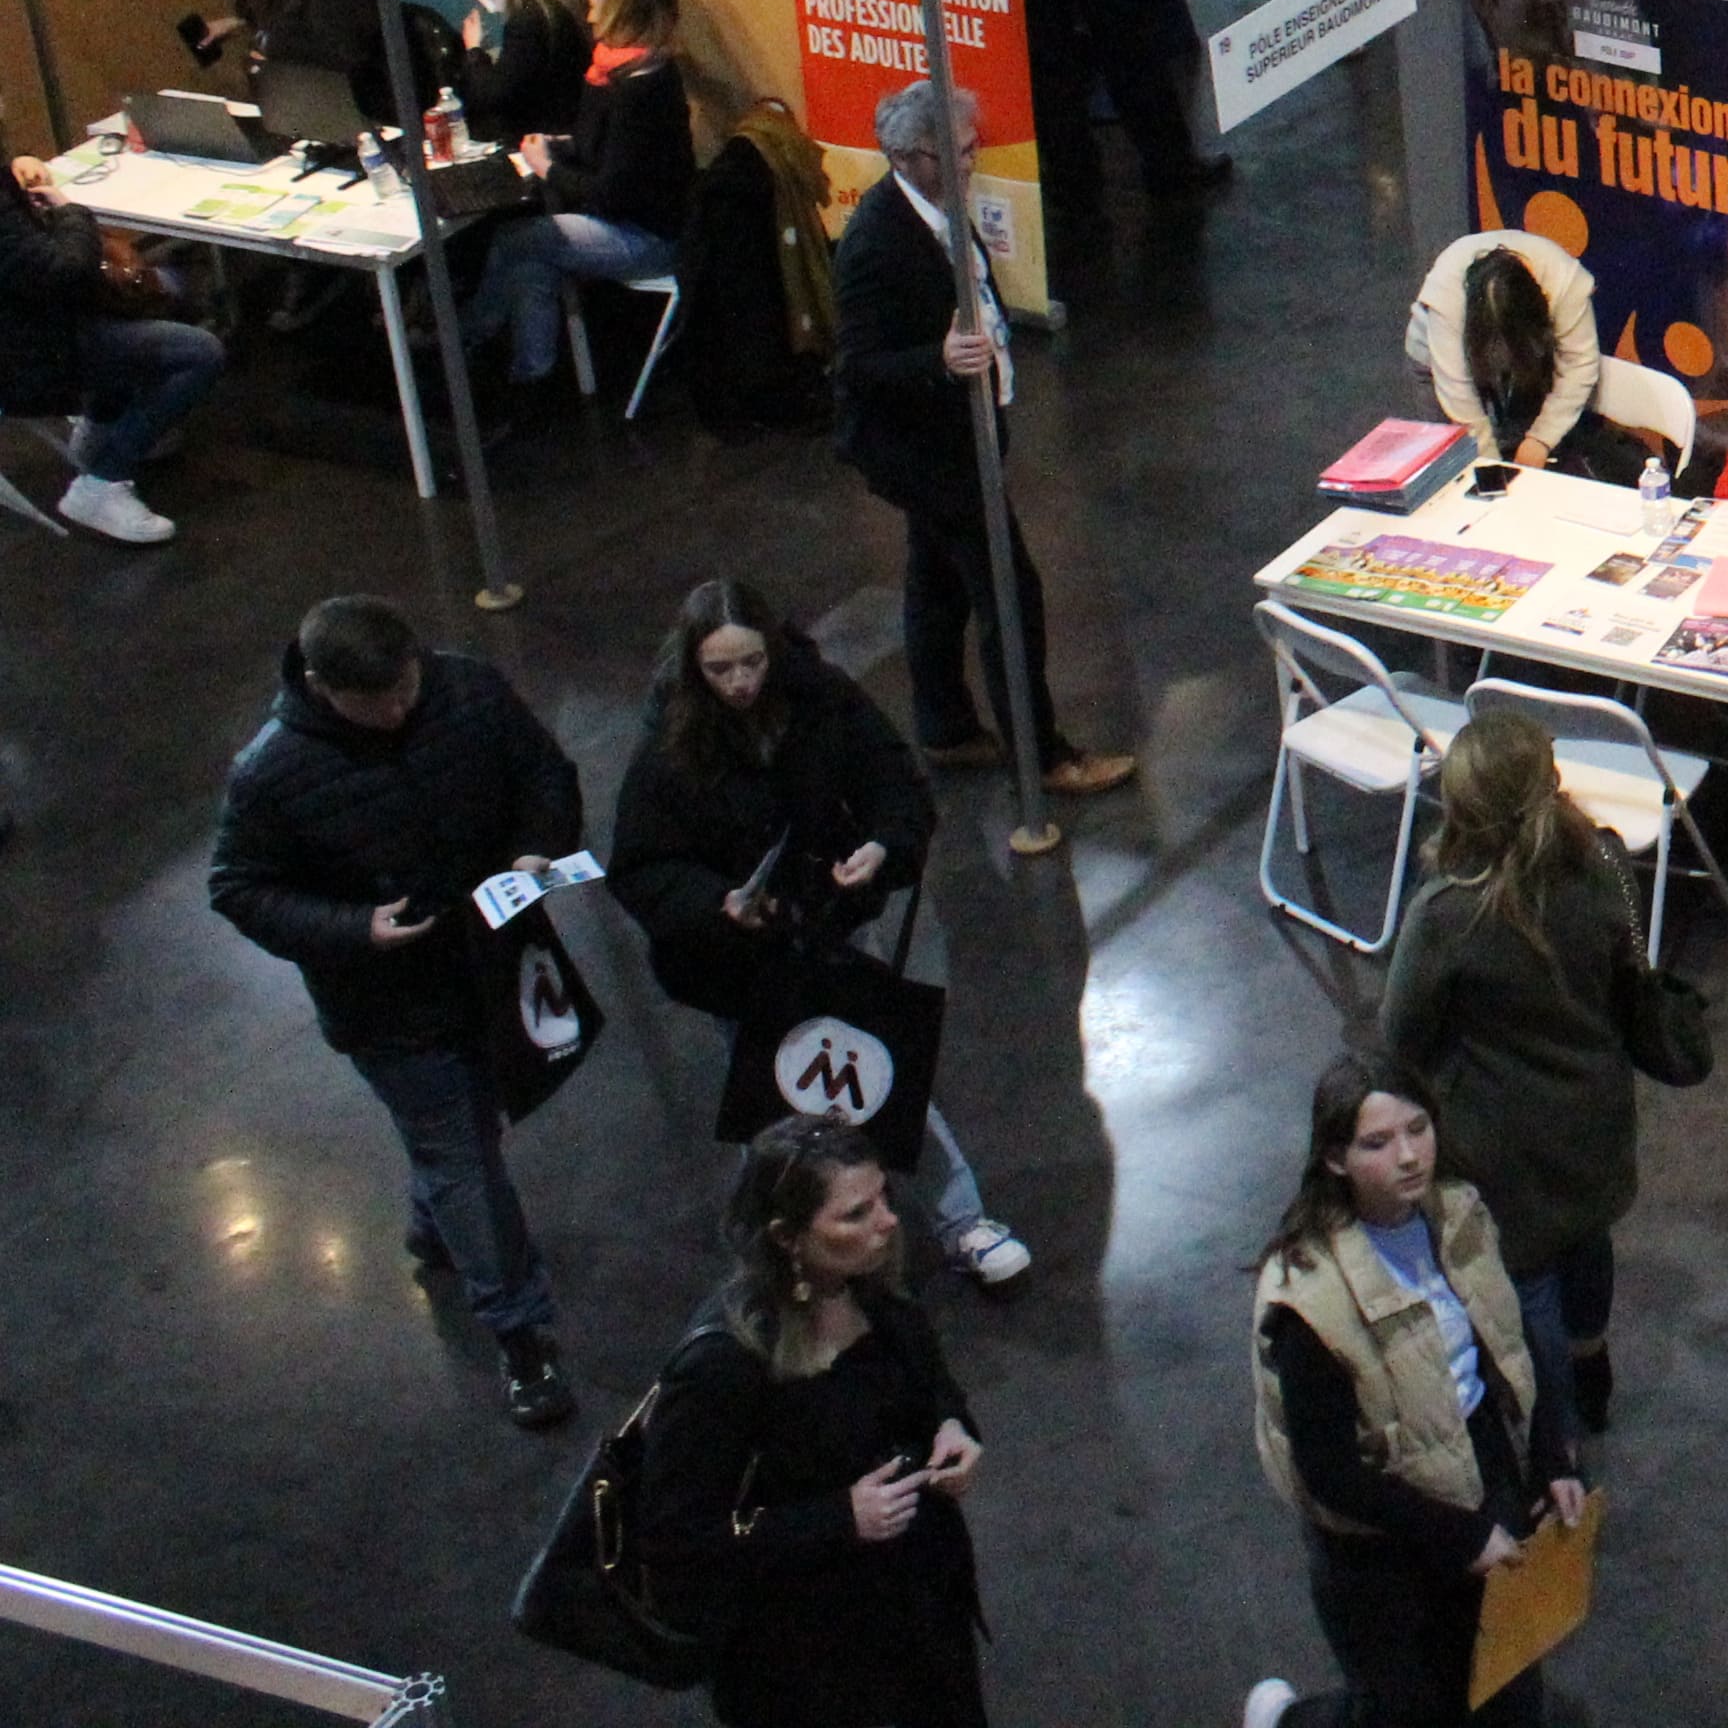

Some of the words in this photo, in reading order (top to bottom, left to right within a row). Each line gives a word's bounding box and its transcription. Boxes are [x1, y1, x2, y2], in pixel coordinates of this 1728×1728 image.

[807, 23, 845, 59] DES
[1572, 5, 1661, 38] BAUDIMONT
[1500, 46, 1535, 95] la
[1503, 94, 1579, 178] du
